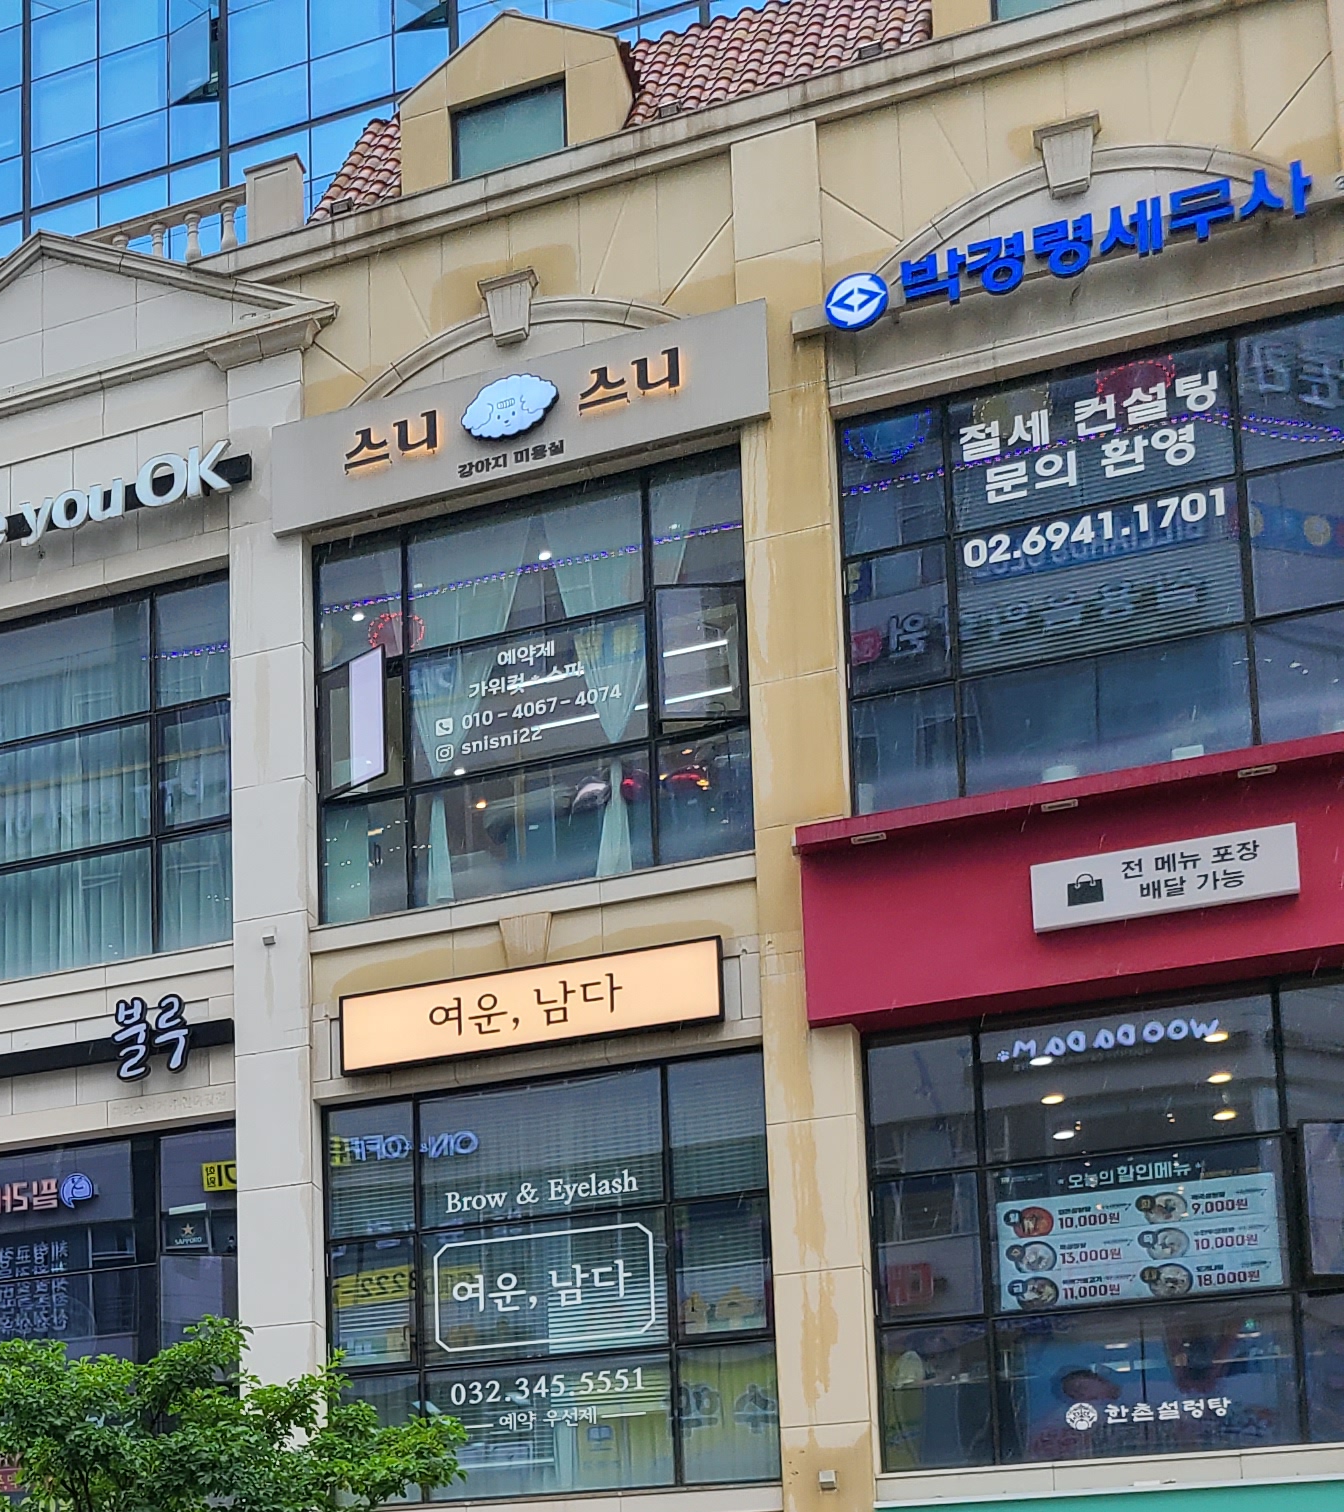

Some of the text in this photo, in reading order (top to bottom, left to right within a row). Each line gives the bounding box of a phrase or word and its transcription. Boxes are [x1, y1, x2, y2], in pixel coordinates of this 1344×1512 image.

[900, 160, 1312, 303] 박경령세무사
[578, 347, 681, 416] 스니
[959, 370, 1218, 463] 절세 컨설팅
[344, 410, 440, 475] 스니
[458, 439, 565, 479] 강아지 미용실
[985, 423, 1197, 504] 문의 환영
[19, 477, 125, 548] you
[135, 439, 233, 508] OK
[964, 487, 1226, 568] 02.6941.1701
[496, 640, 556, 668] 예약제
[460, 726, 543, 756] snisni22
[1120, 839, 1261, 881] 전 메뉴 포장
[1139, 866, 1247, 901] 배달 가능
[534, 973, 623, 1027] 남다
[446, 1169, 639, 1214] Brow & Eyelash
[1117, 1161, 1192, 1183] 할인메뉴
[1058, 1212, 1121, 1229] 10,000원
[1191, 1198, 1249, 1215] 9,000원
[548, 1260, 632, 1307] 남다
[450, 1368, 645, 1406] 032.345.5551
[498, 1407, 597, 1432] 예약 우선제
[1104, 1397, 1232, 1424] 한촌설렁탕
